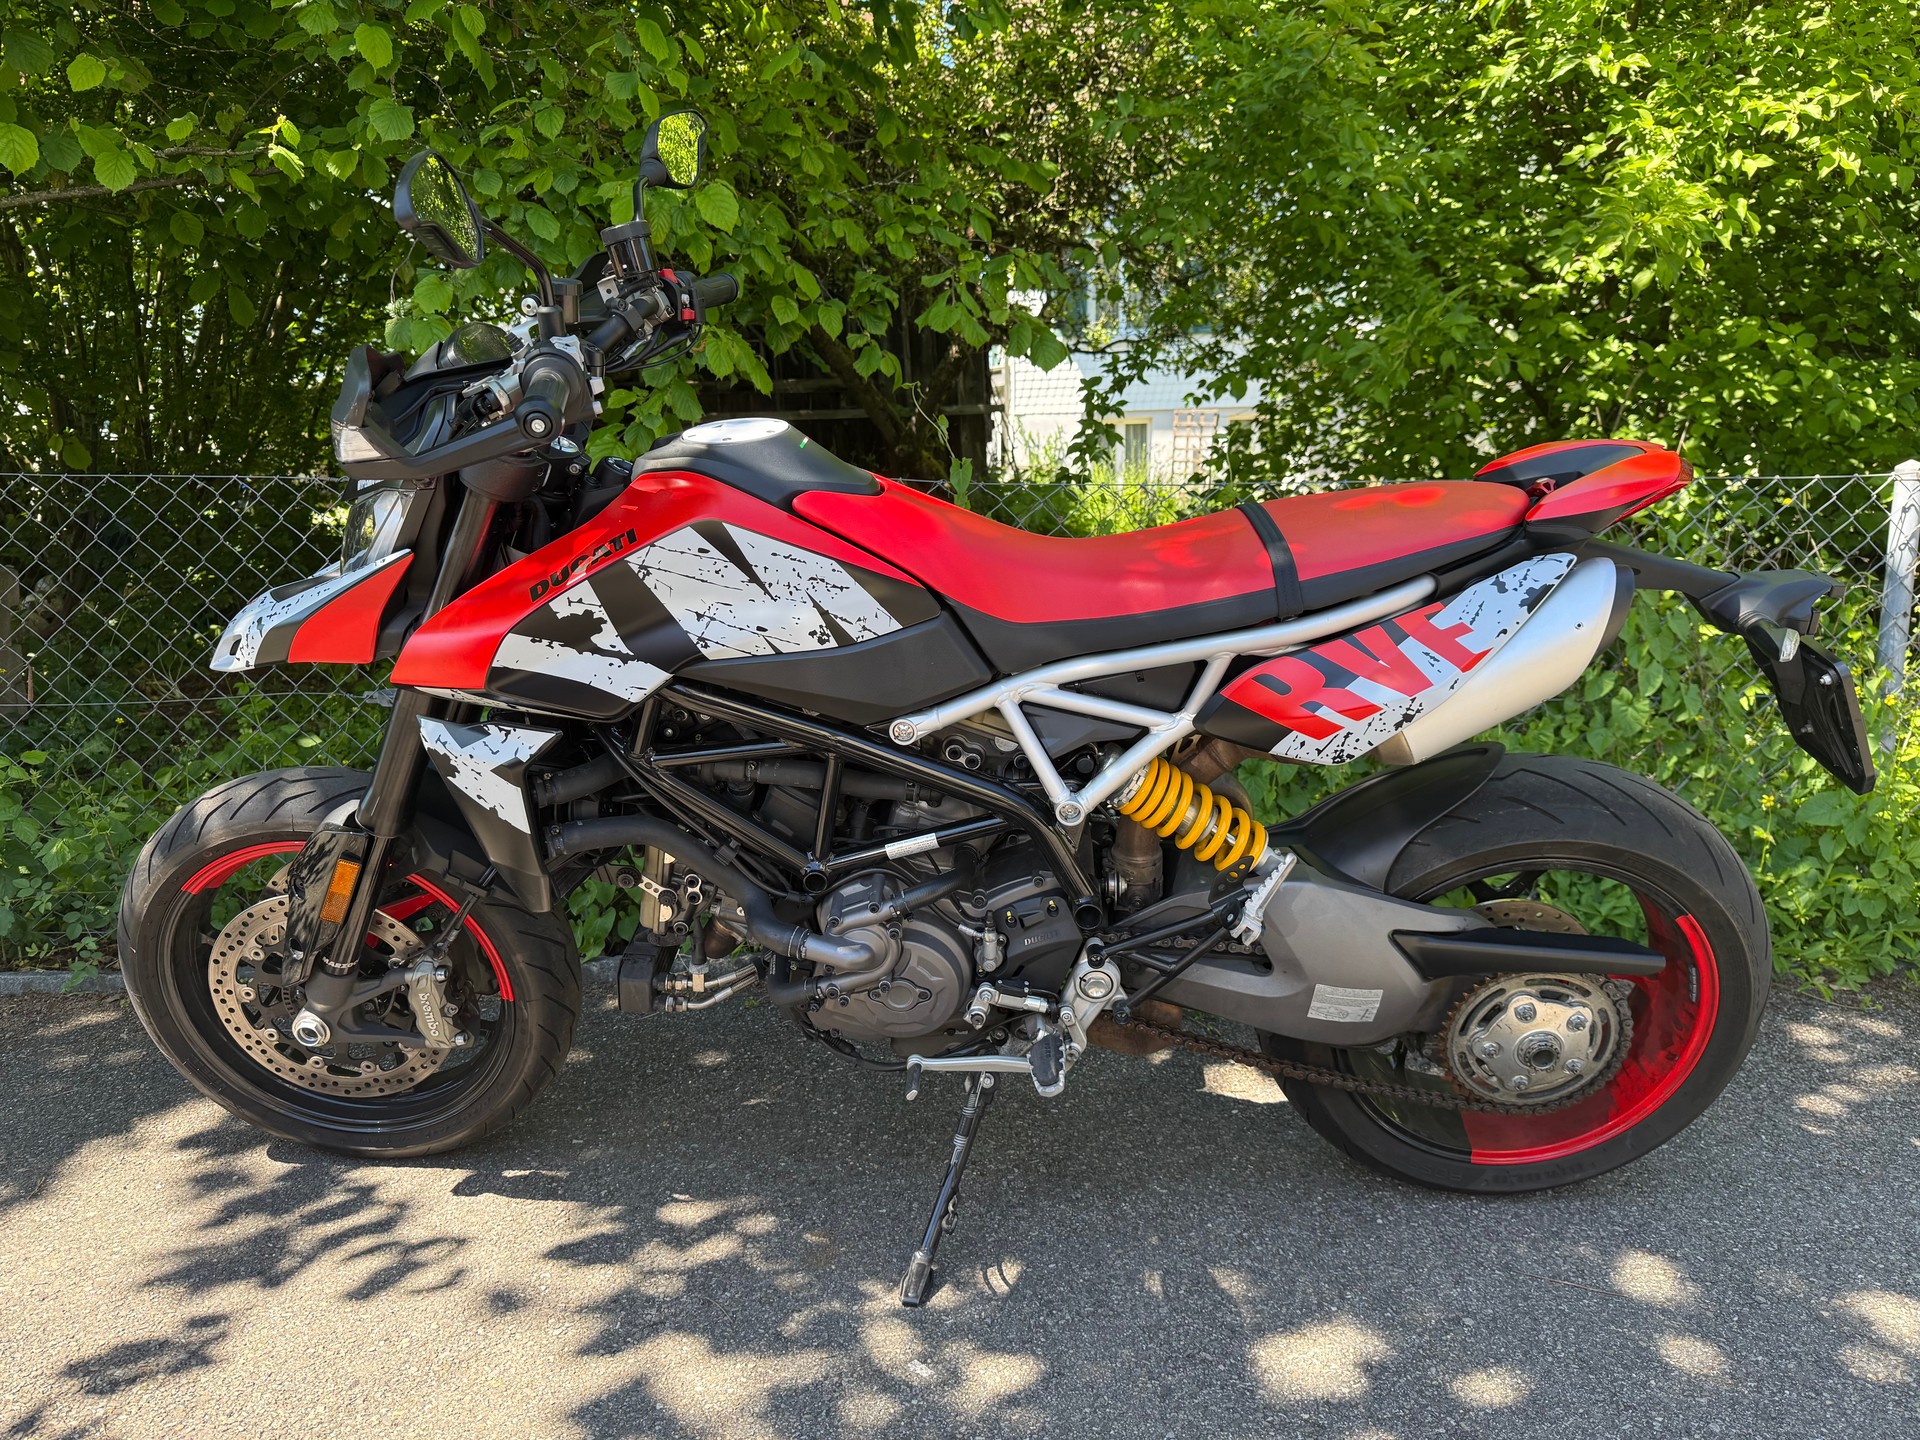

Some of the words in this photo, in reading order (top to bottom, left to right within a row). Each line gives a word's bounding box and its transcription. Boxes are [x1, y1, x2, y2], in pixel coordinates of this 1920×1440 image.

[529, 528, 637, 602] DUCATI
[1219, 601, 1495, 741] RVE
[418, 992, 439, 1037] brembo
